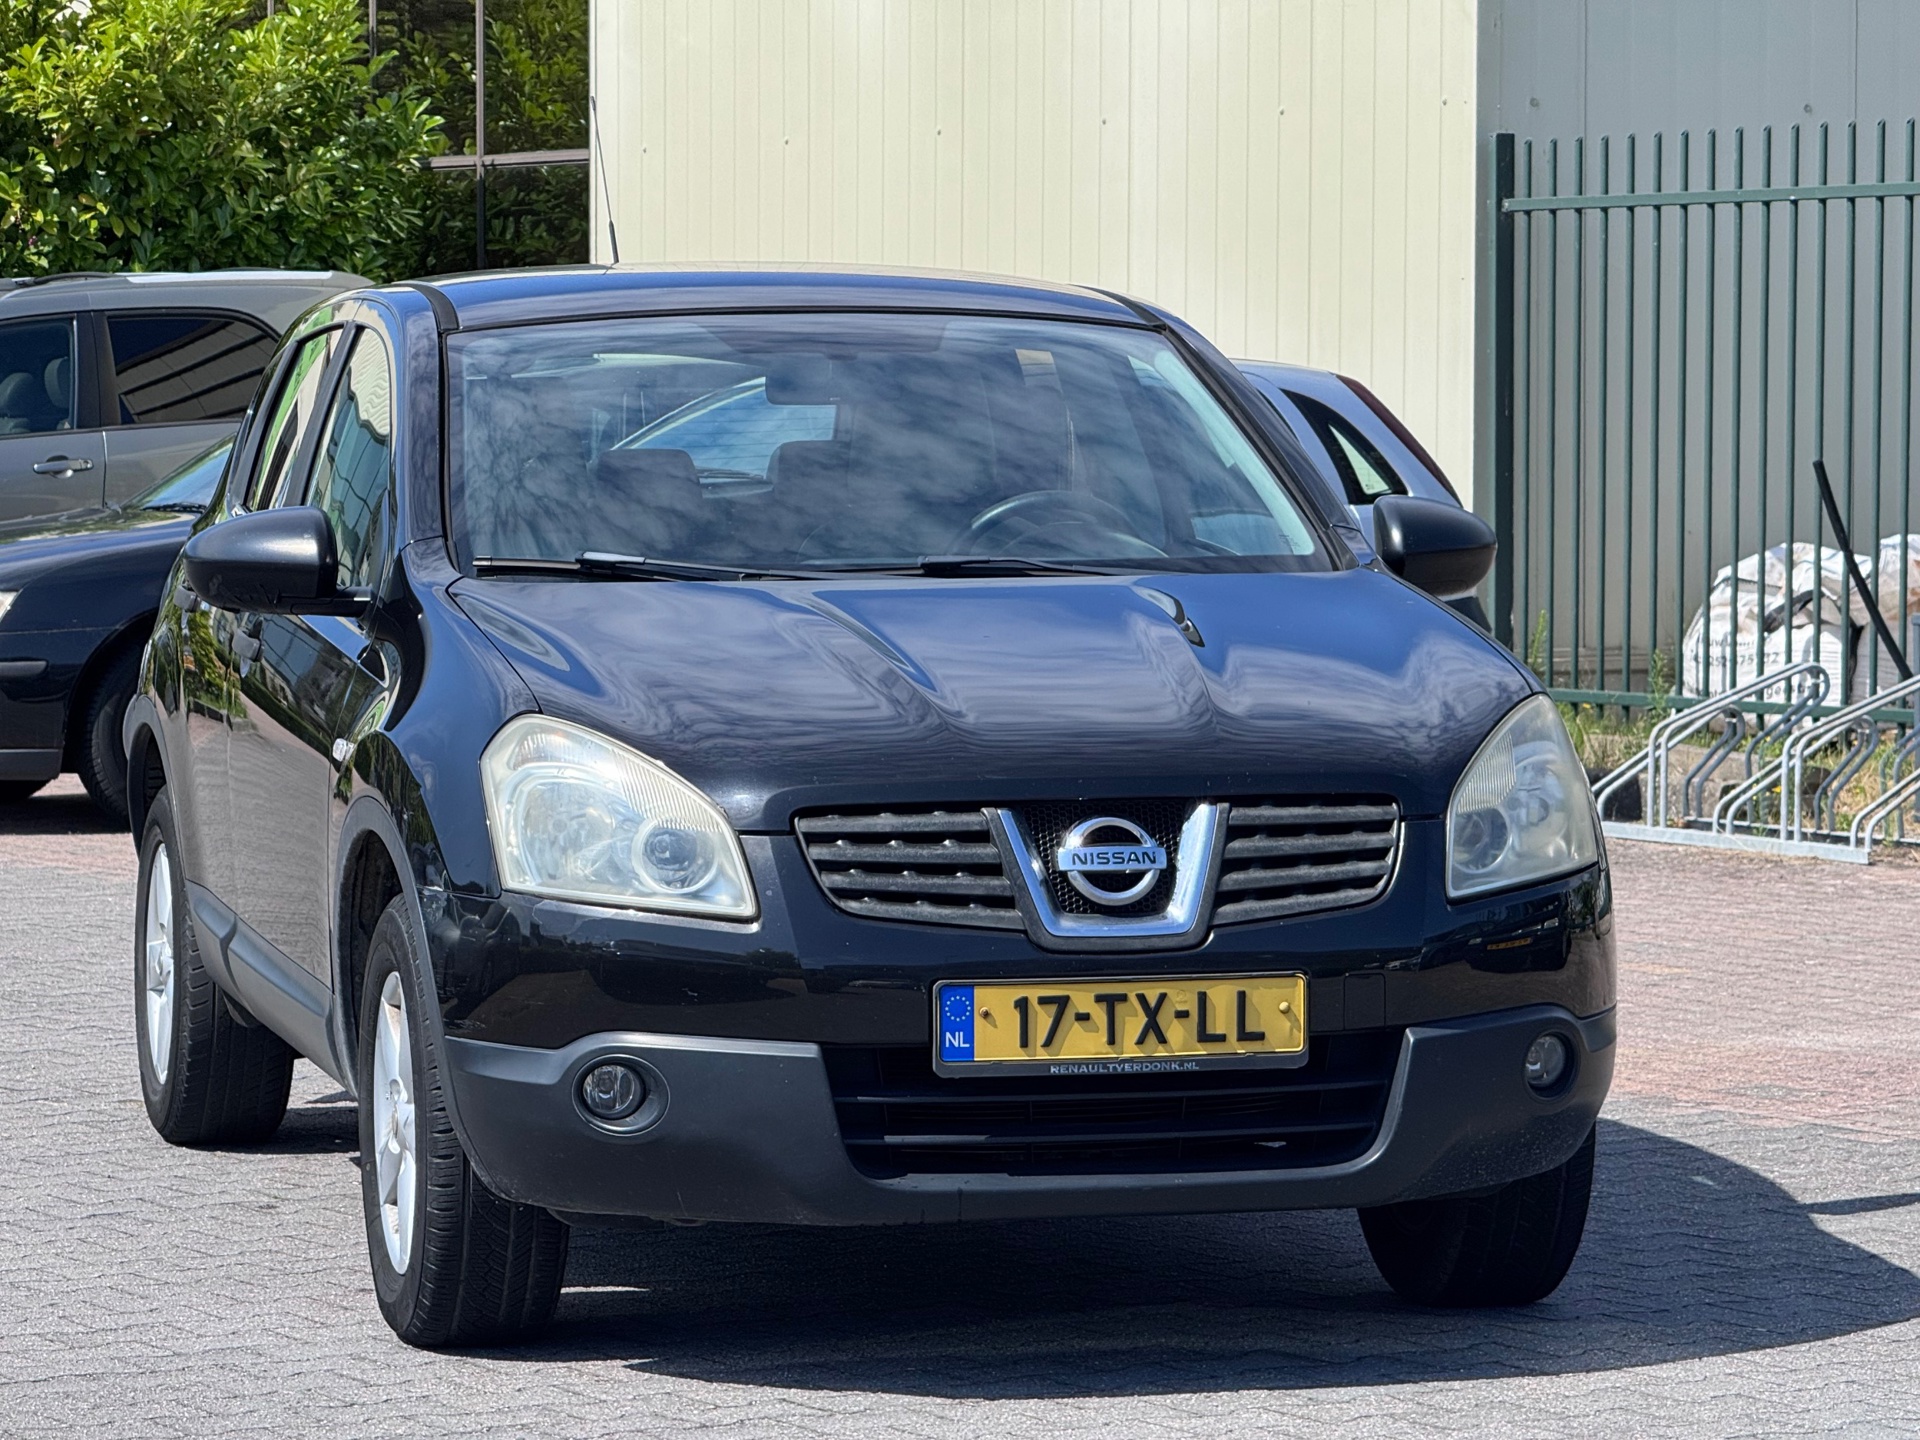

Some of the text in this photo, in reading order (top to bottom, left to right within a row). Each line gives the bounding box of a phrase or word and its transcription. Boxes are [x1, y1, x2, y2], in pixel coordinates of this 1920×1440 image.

[1071, 851, 1157, 866] NISSAN
[1013, 989, 1266, 1049] 17-TX-LL
[945, 1031, 971, 1048] NL
[1050, 1061, 1200, 1075] RENAULTVERDONK.NL
